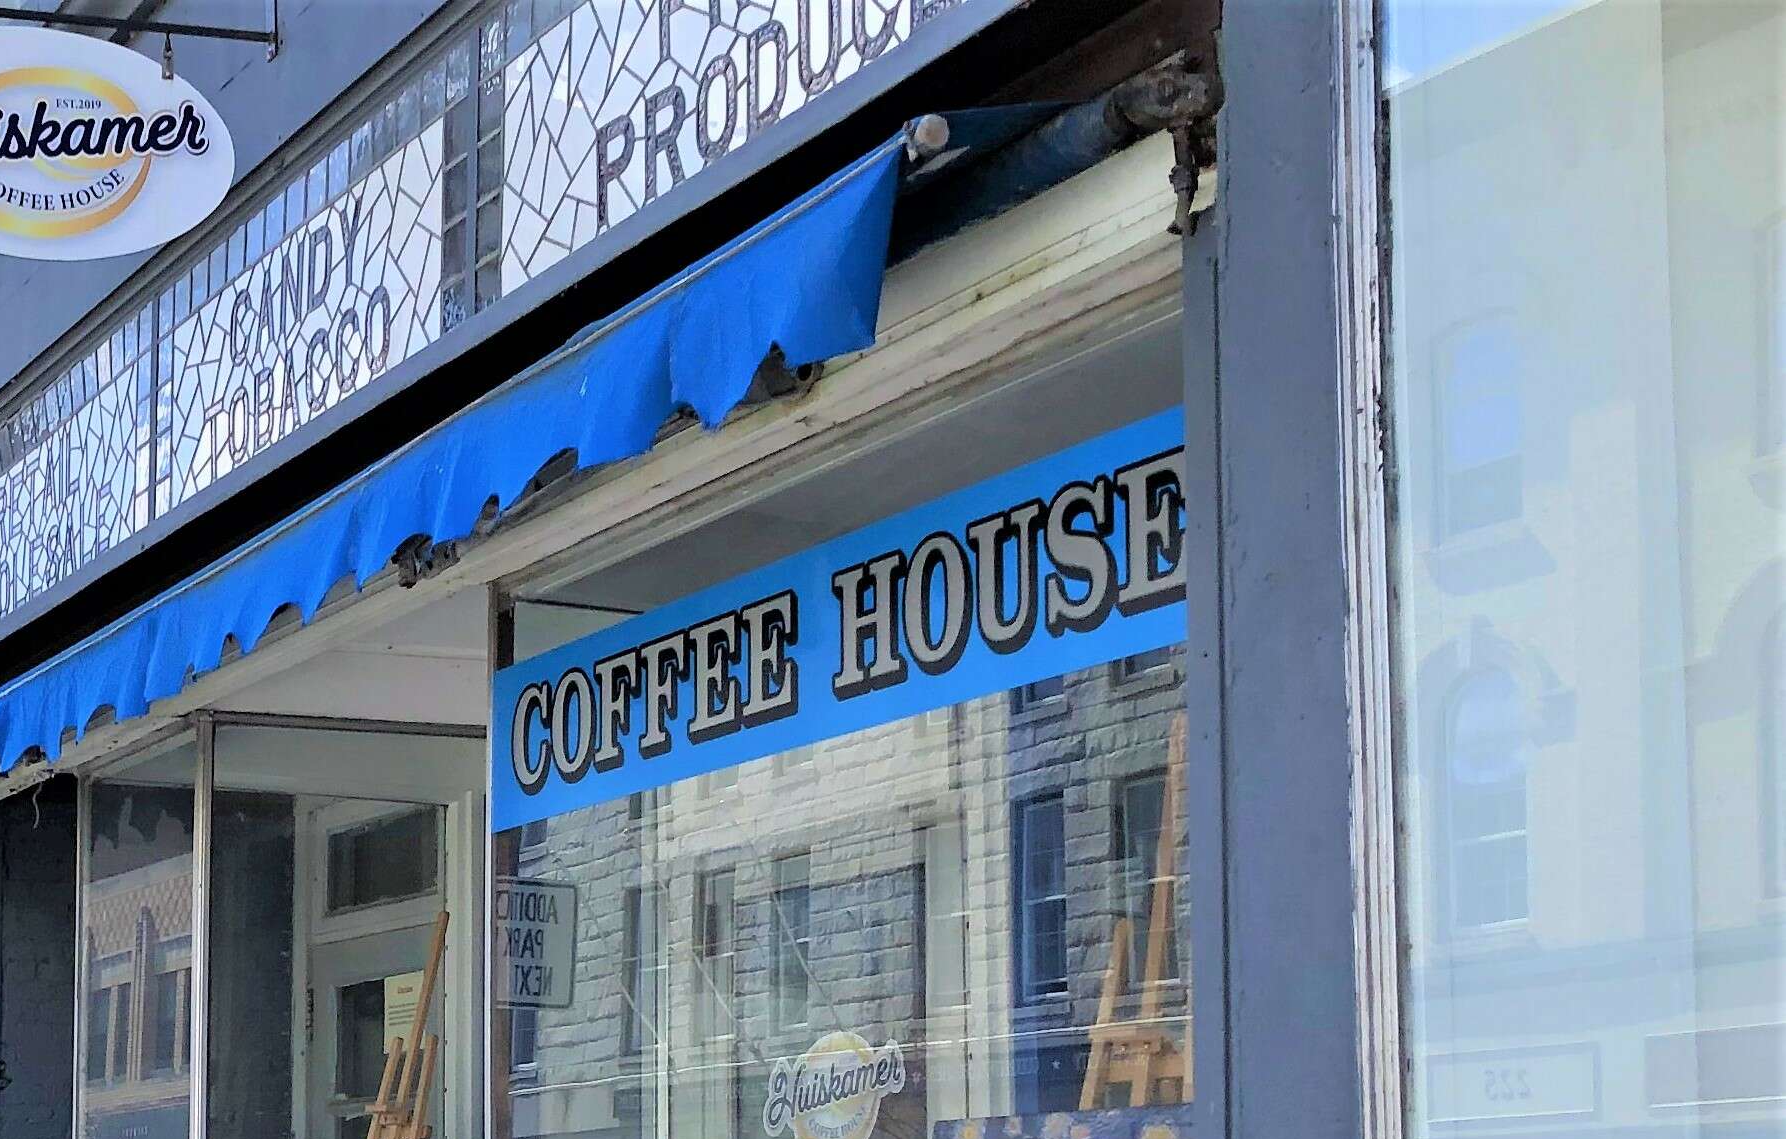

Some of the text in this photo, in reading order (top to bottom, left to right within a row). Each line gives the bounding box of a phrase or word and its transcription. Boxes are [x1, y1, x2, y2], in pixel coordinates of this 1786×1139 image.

[61, 170, 125, 210] HOUSE
[230, 199, 365, 367] CANDY
[204, 286, 391, 481] TOBACCO
[512, 446, 1187, 795] COFFEE HOUSE
[767, 1050, 901, 1126] Huiskamer
